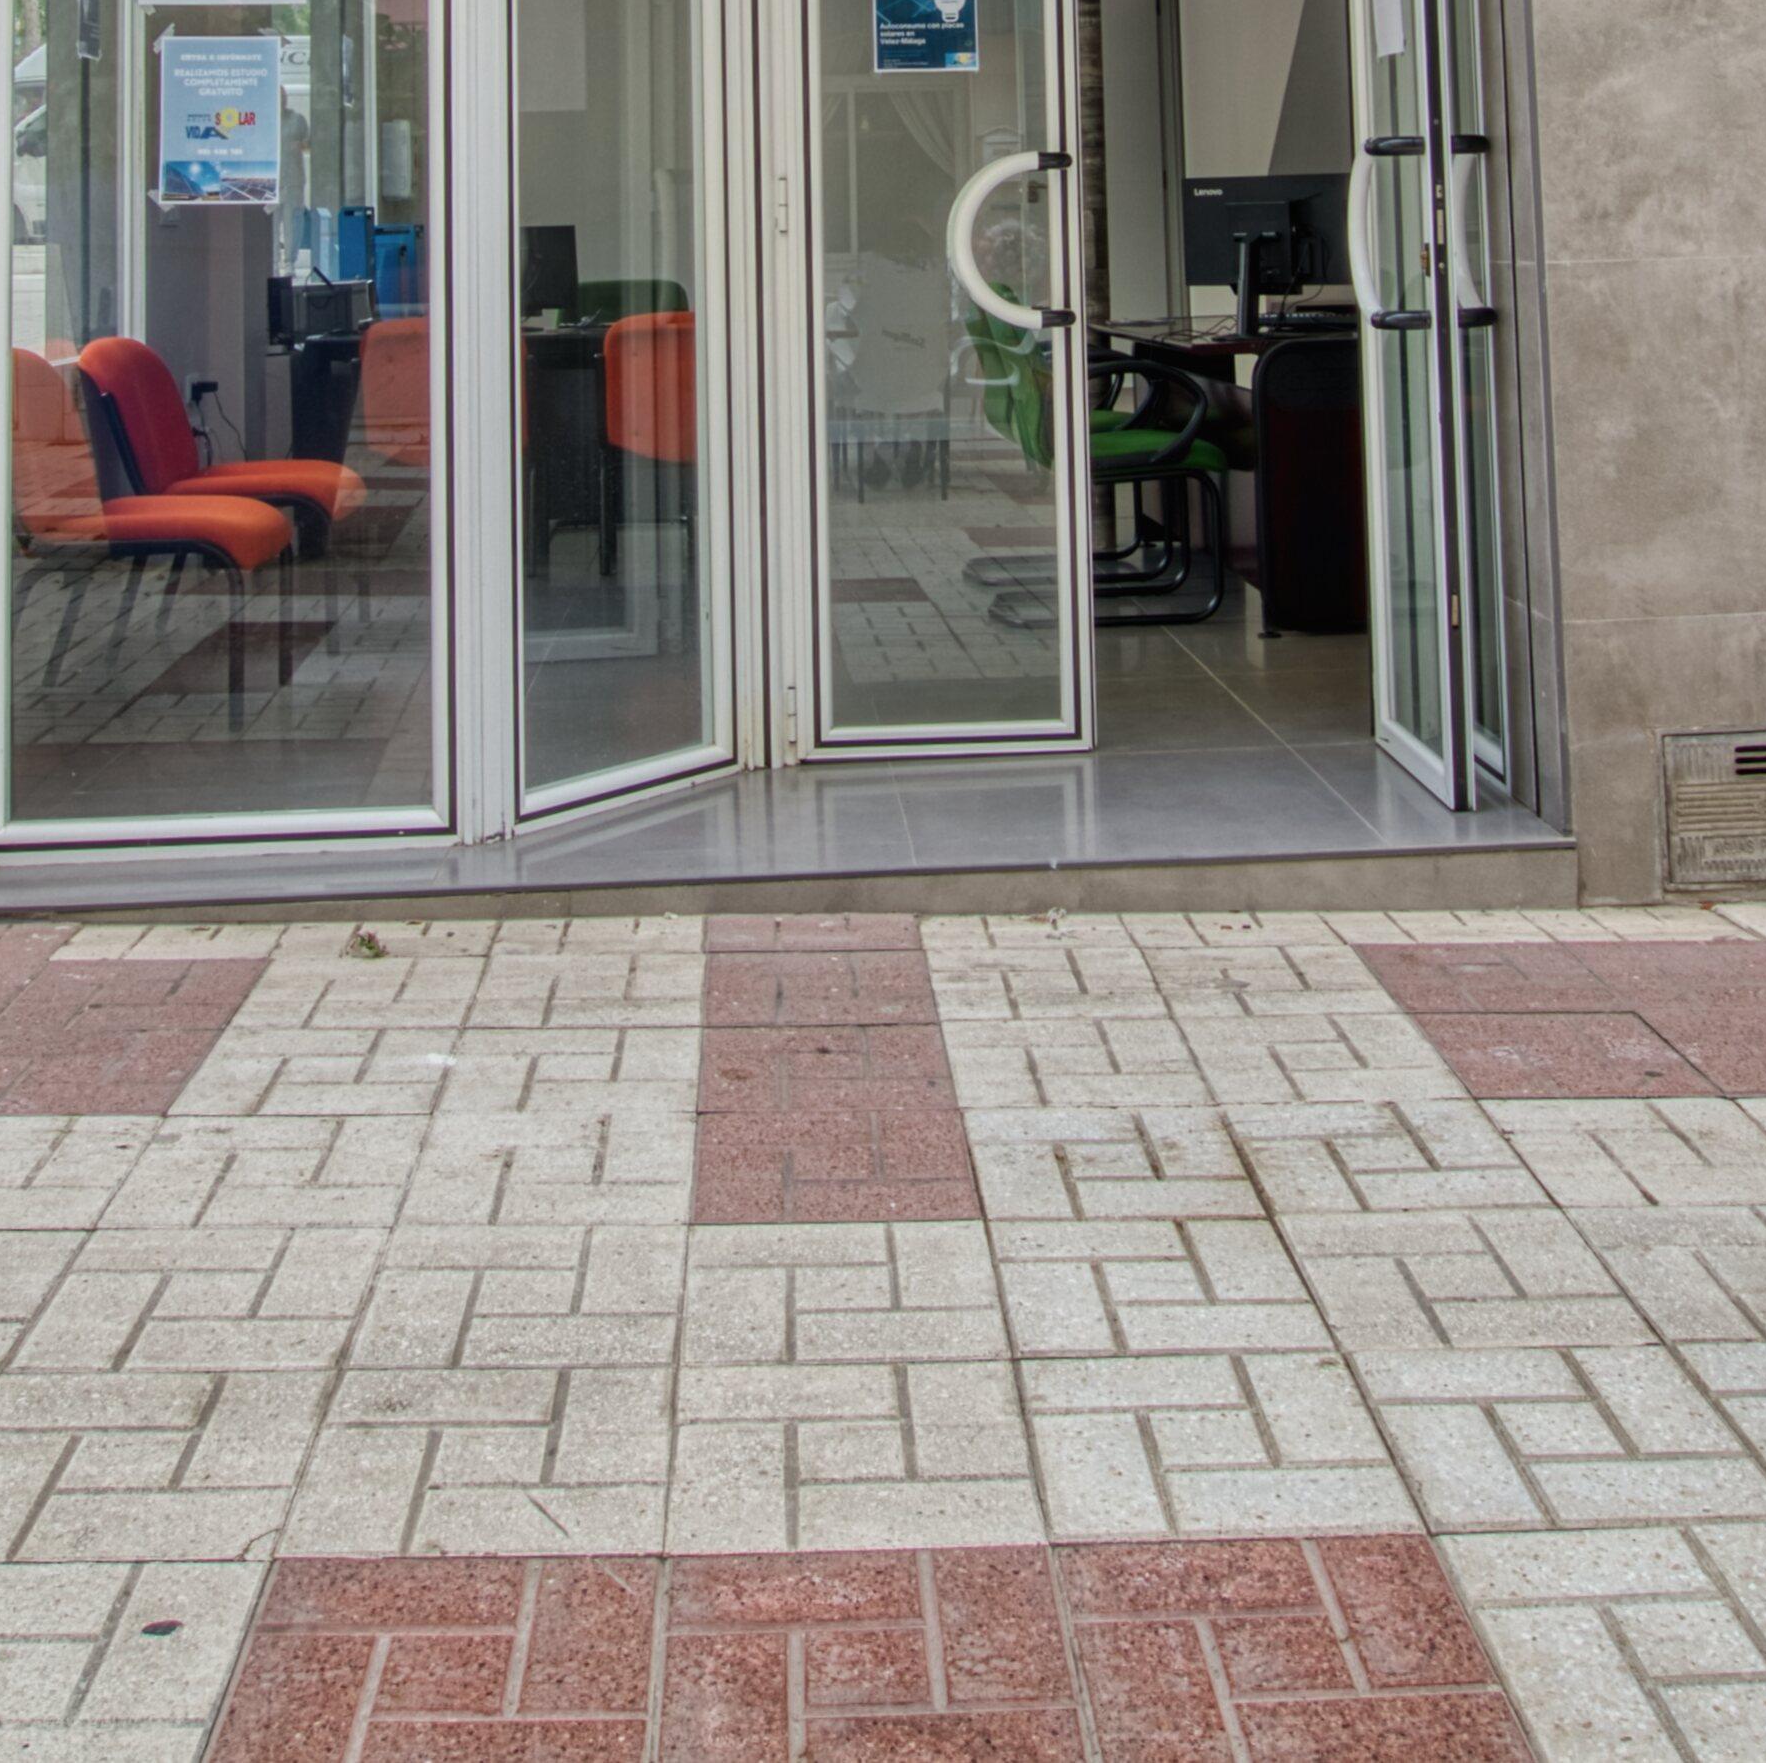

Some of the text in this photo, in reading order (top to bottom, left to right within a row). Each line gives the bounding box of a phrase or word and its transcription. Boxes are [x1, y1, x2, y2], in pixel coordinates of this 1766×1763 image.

[173, 68, 268, 77] REALIZAMOS ESTUDIO
[183, 78, 258, 87] COMPLETAMENTE
[198, 87, 244, 96] GRATUITO
[1193, 188, 1224, 197] Lenovo
